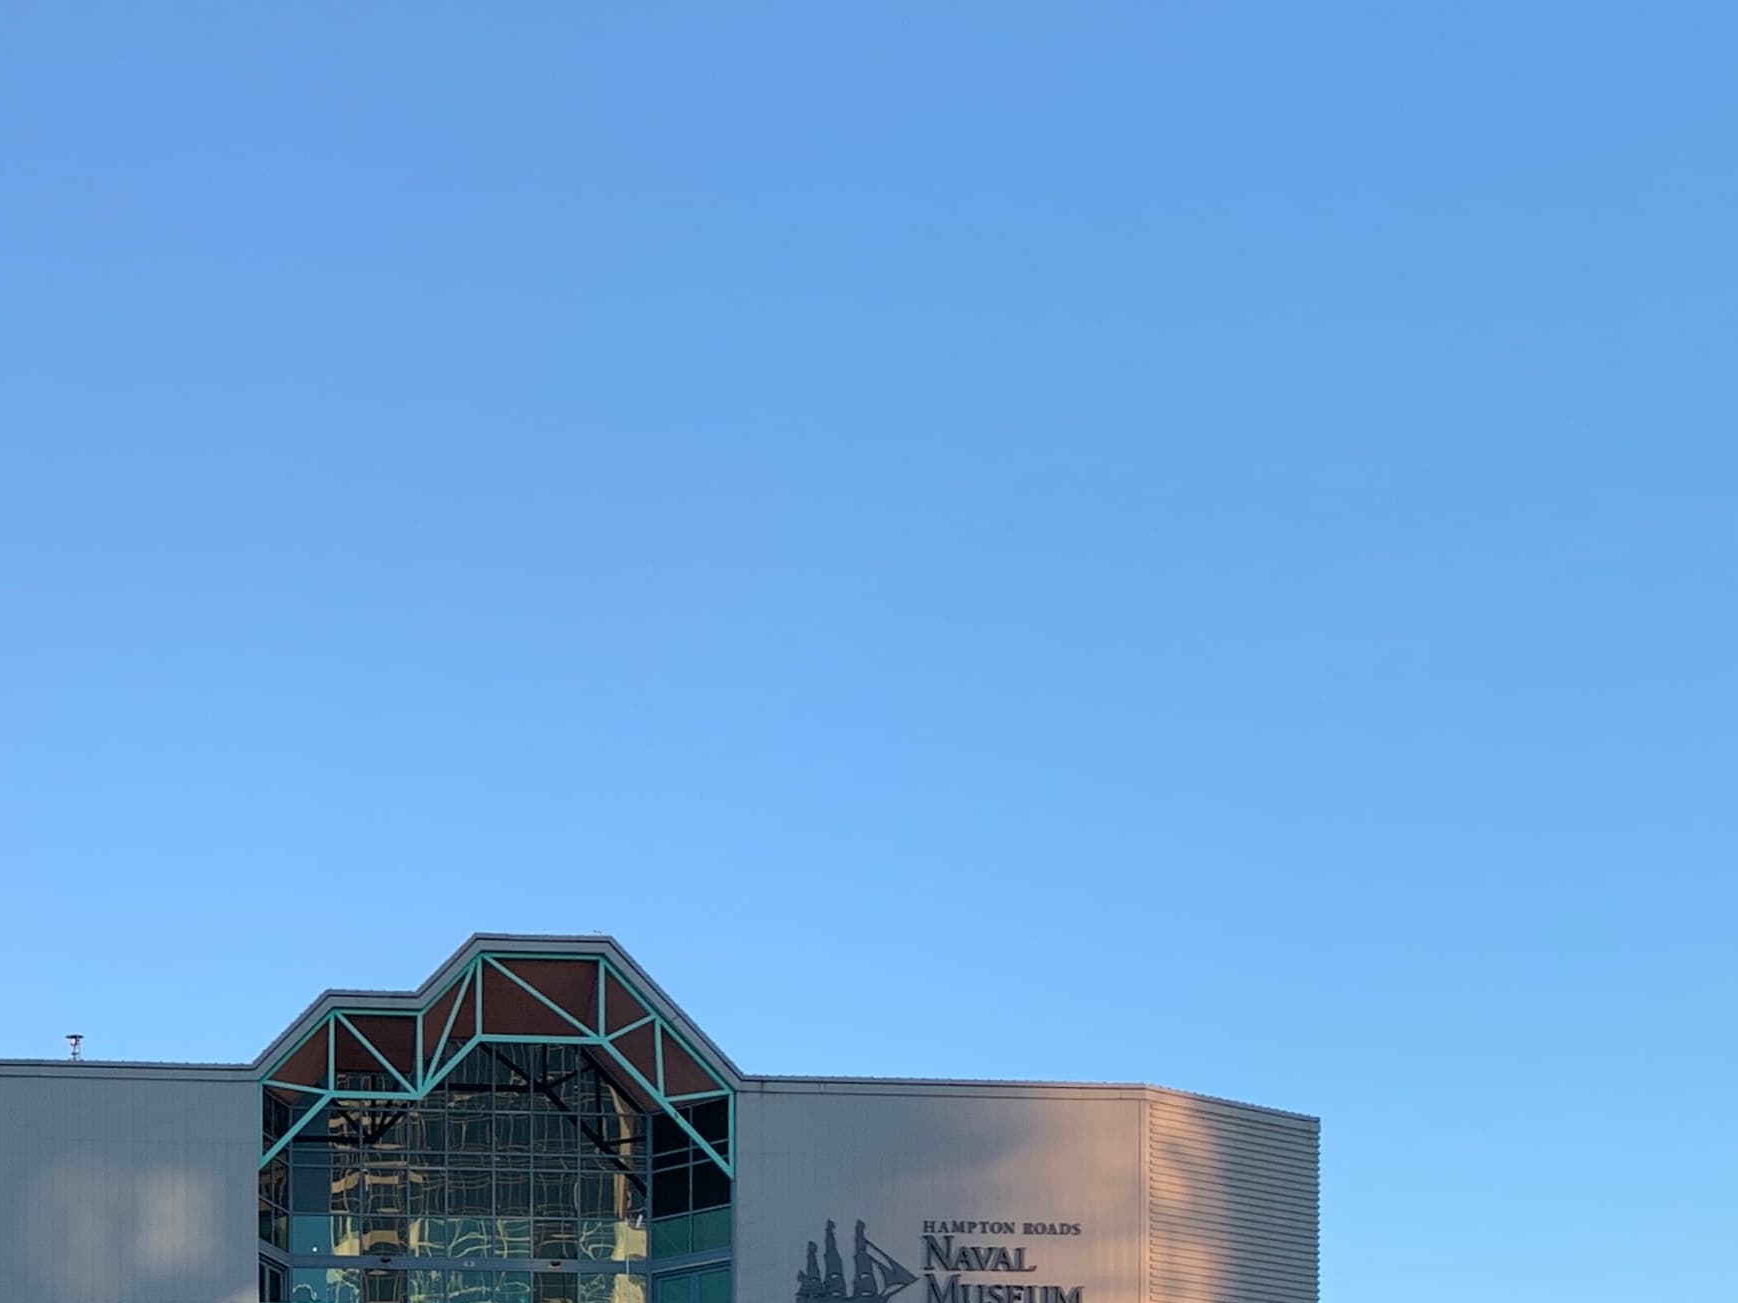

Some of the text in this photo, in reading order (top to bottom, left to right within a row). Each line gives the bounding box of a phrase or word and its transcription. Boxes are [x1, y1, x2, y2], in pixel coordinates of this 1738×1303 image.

[922, 1220, 1082, 1236] HAMPTON ROADS
[922, 1235, 1038, 1272] NAVAL
